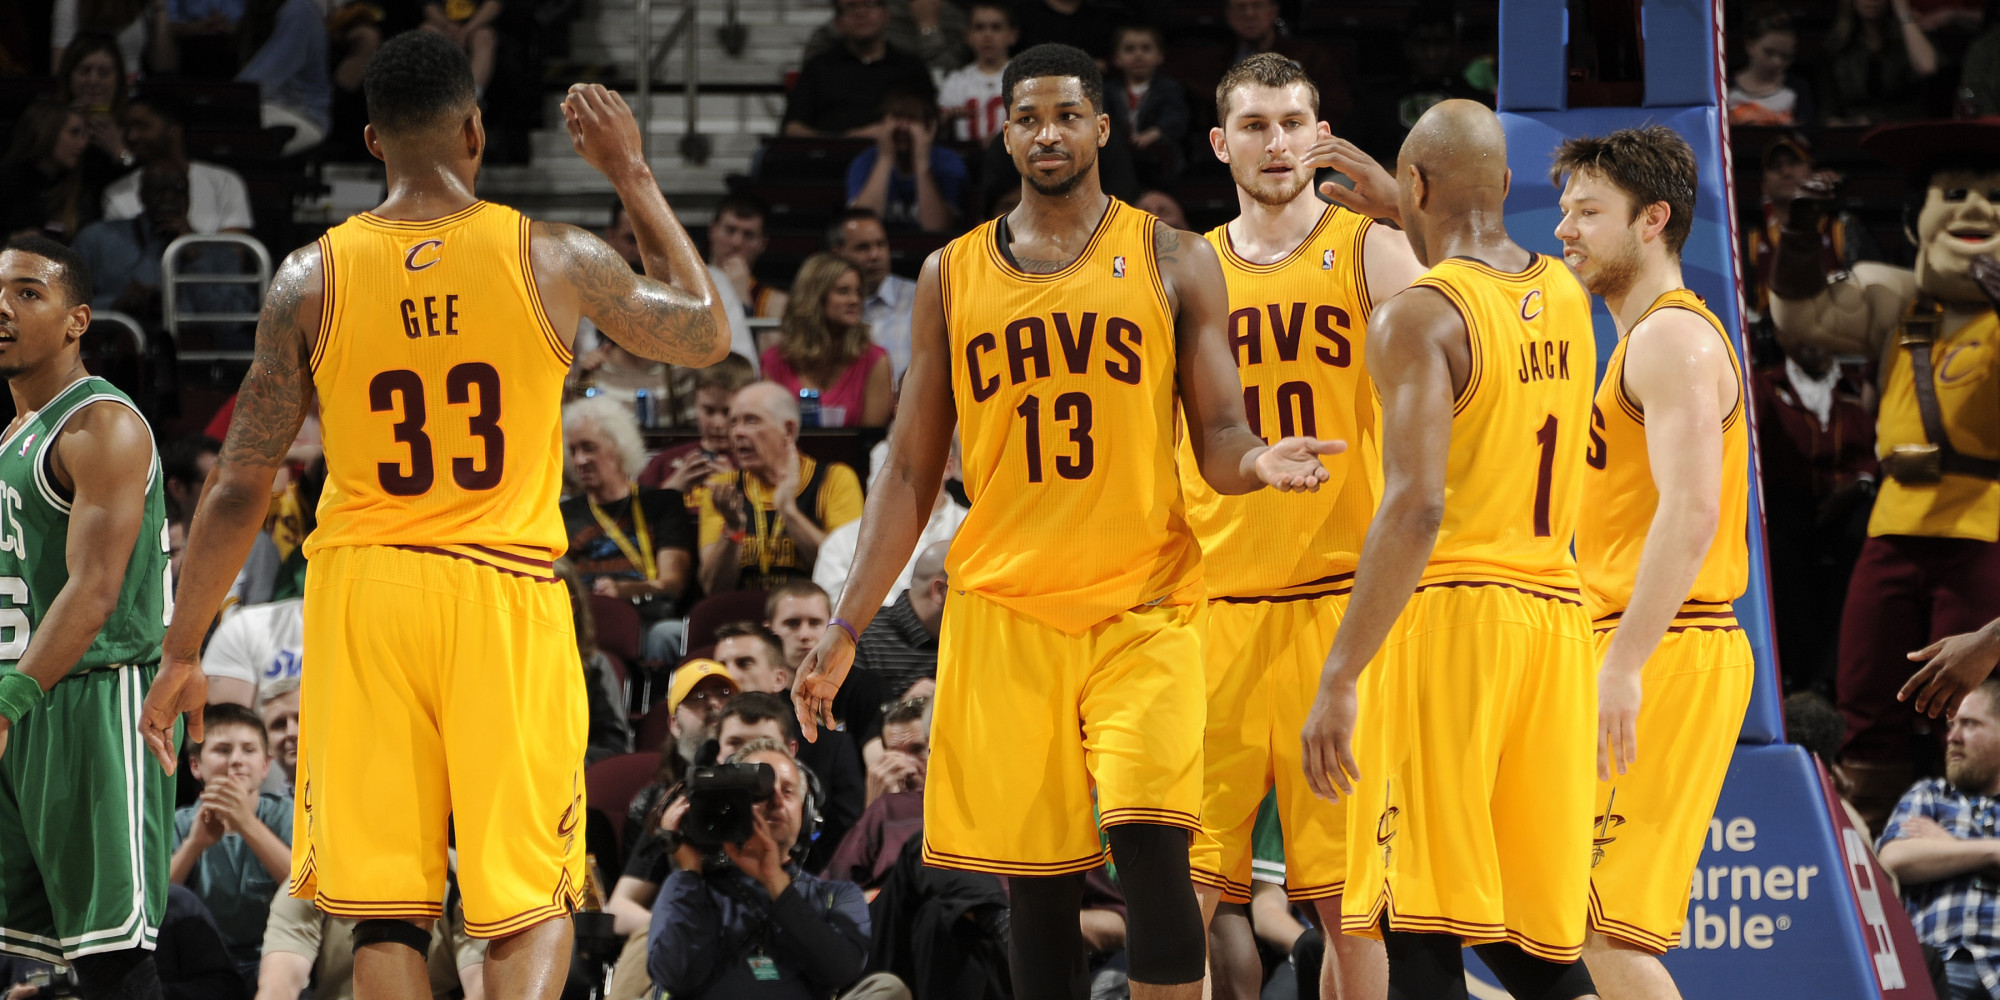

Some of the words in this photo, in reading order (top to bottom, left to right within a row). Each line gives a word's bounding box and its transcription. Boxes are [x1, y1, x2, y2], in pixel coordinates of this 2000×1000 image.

[400, 295, 459, 340] GEE
[966, 312, 1143, 403] CAVS
[1228, 302, 1351, 369] AVS
[1518, 340, 1570, 384] JACK
[369, 362, 505, 497] 33
[1016, 391, 1094, 484] 13
[1534, 414, 1558, 537] 1
